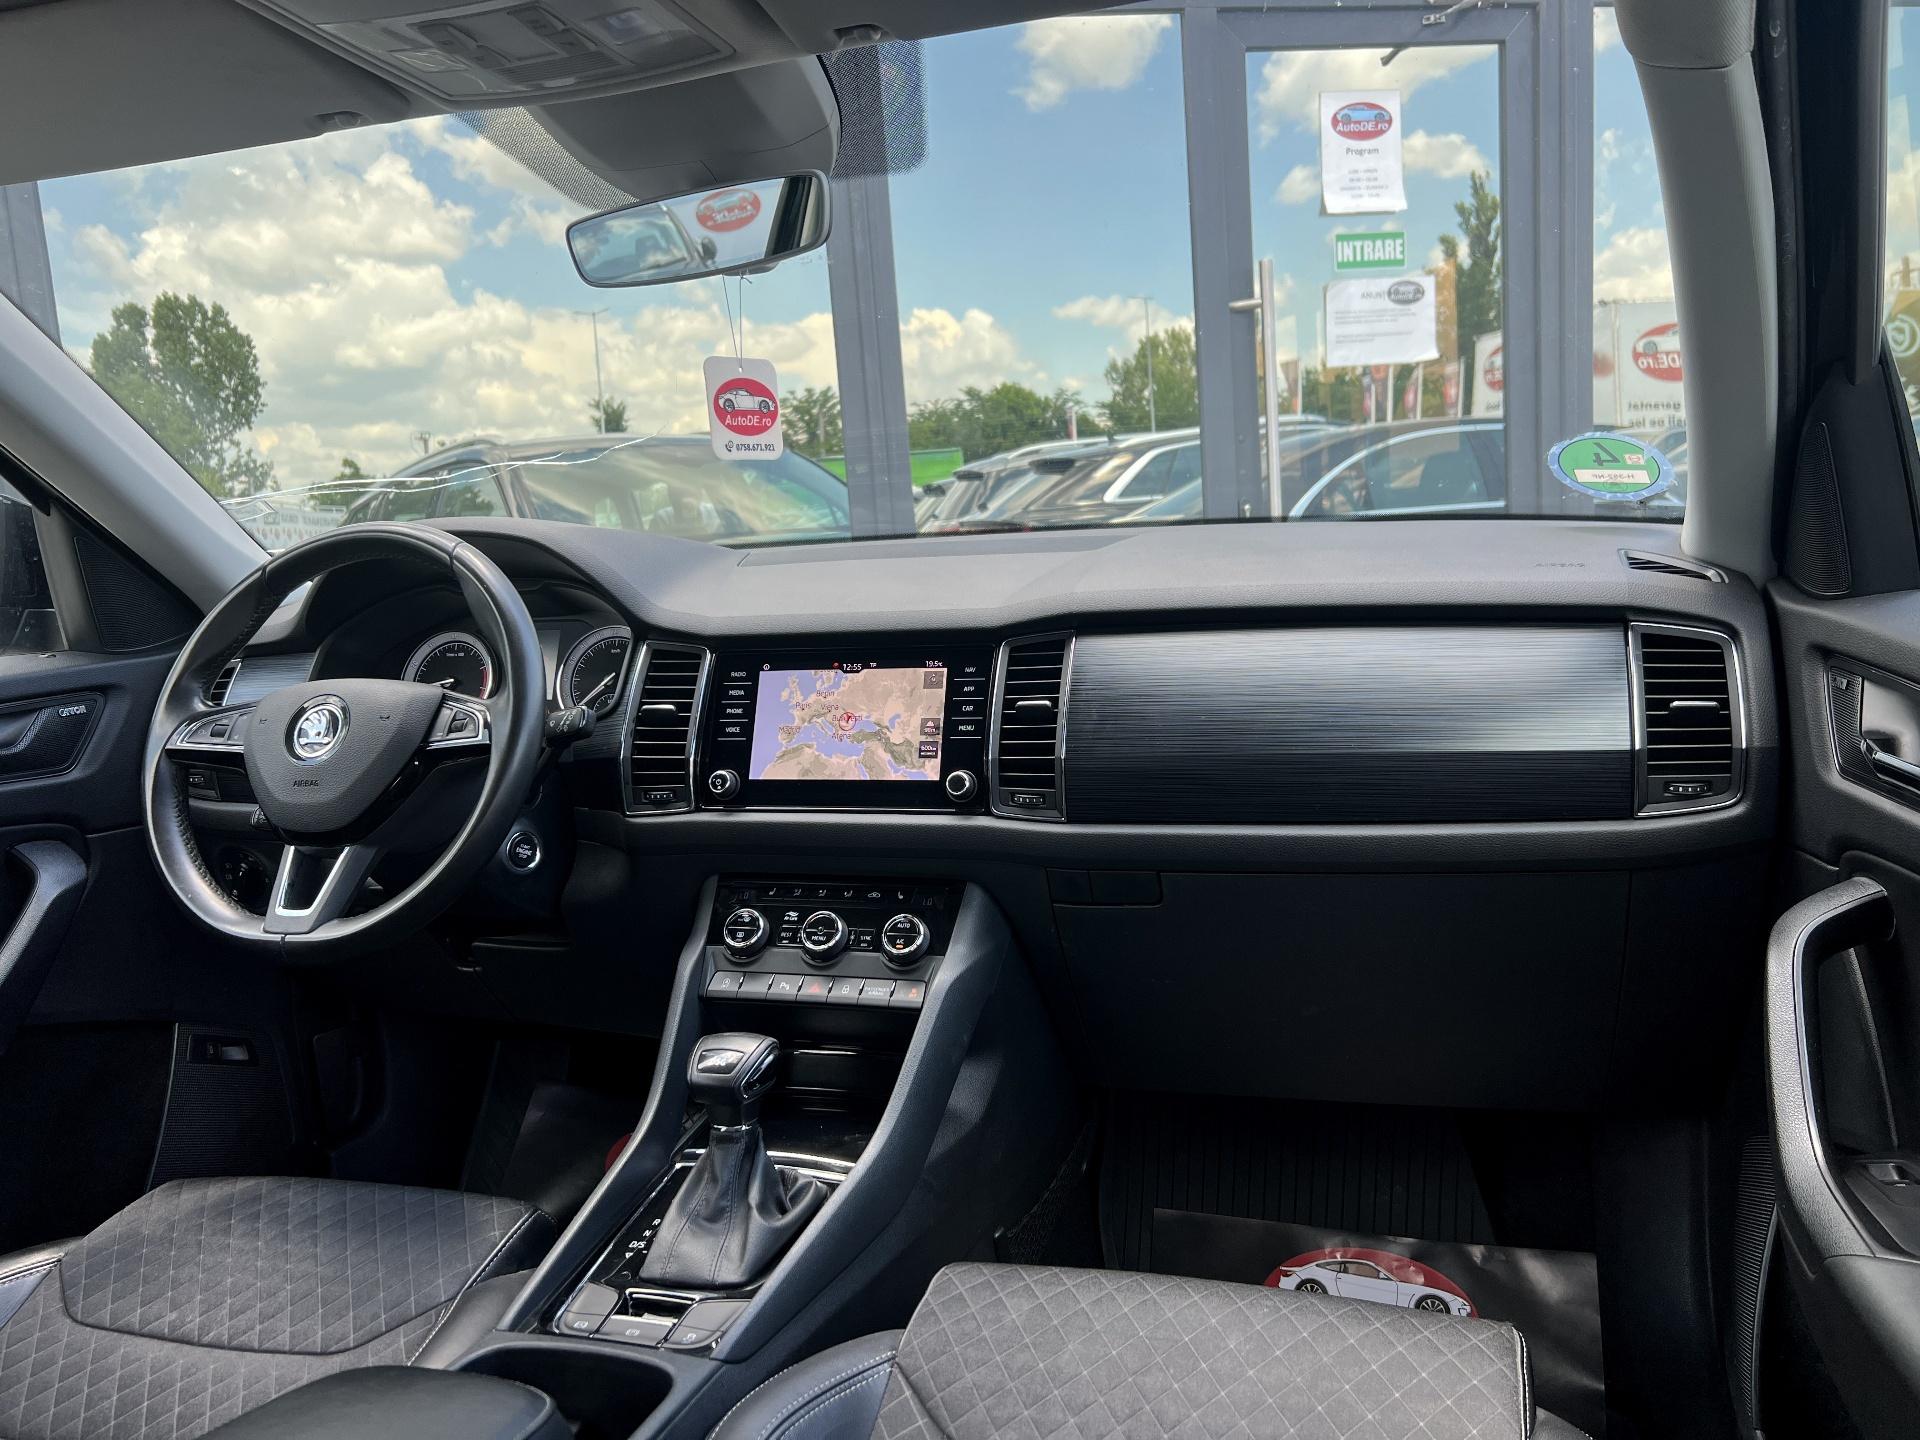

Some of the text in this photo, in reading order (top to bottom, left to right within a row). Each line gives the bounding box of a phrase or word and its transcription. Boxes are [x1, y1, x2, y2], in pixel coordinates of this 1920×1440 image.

[1336, 121, 1388, 132] AutoDE.ro
[1345, 147, 1379, 157] Program
[1337, 239, 1404, 263] INTRARE
[725, 414, 772, 427] AutoDE.ro
[843, 663, 862, 671] 12:55
[652, 1218, 661, 1226] R
[642, 1229, 652, 1237] N
[628, 1240, 647, 1248] D/S
